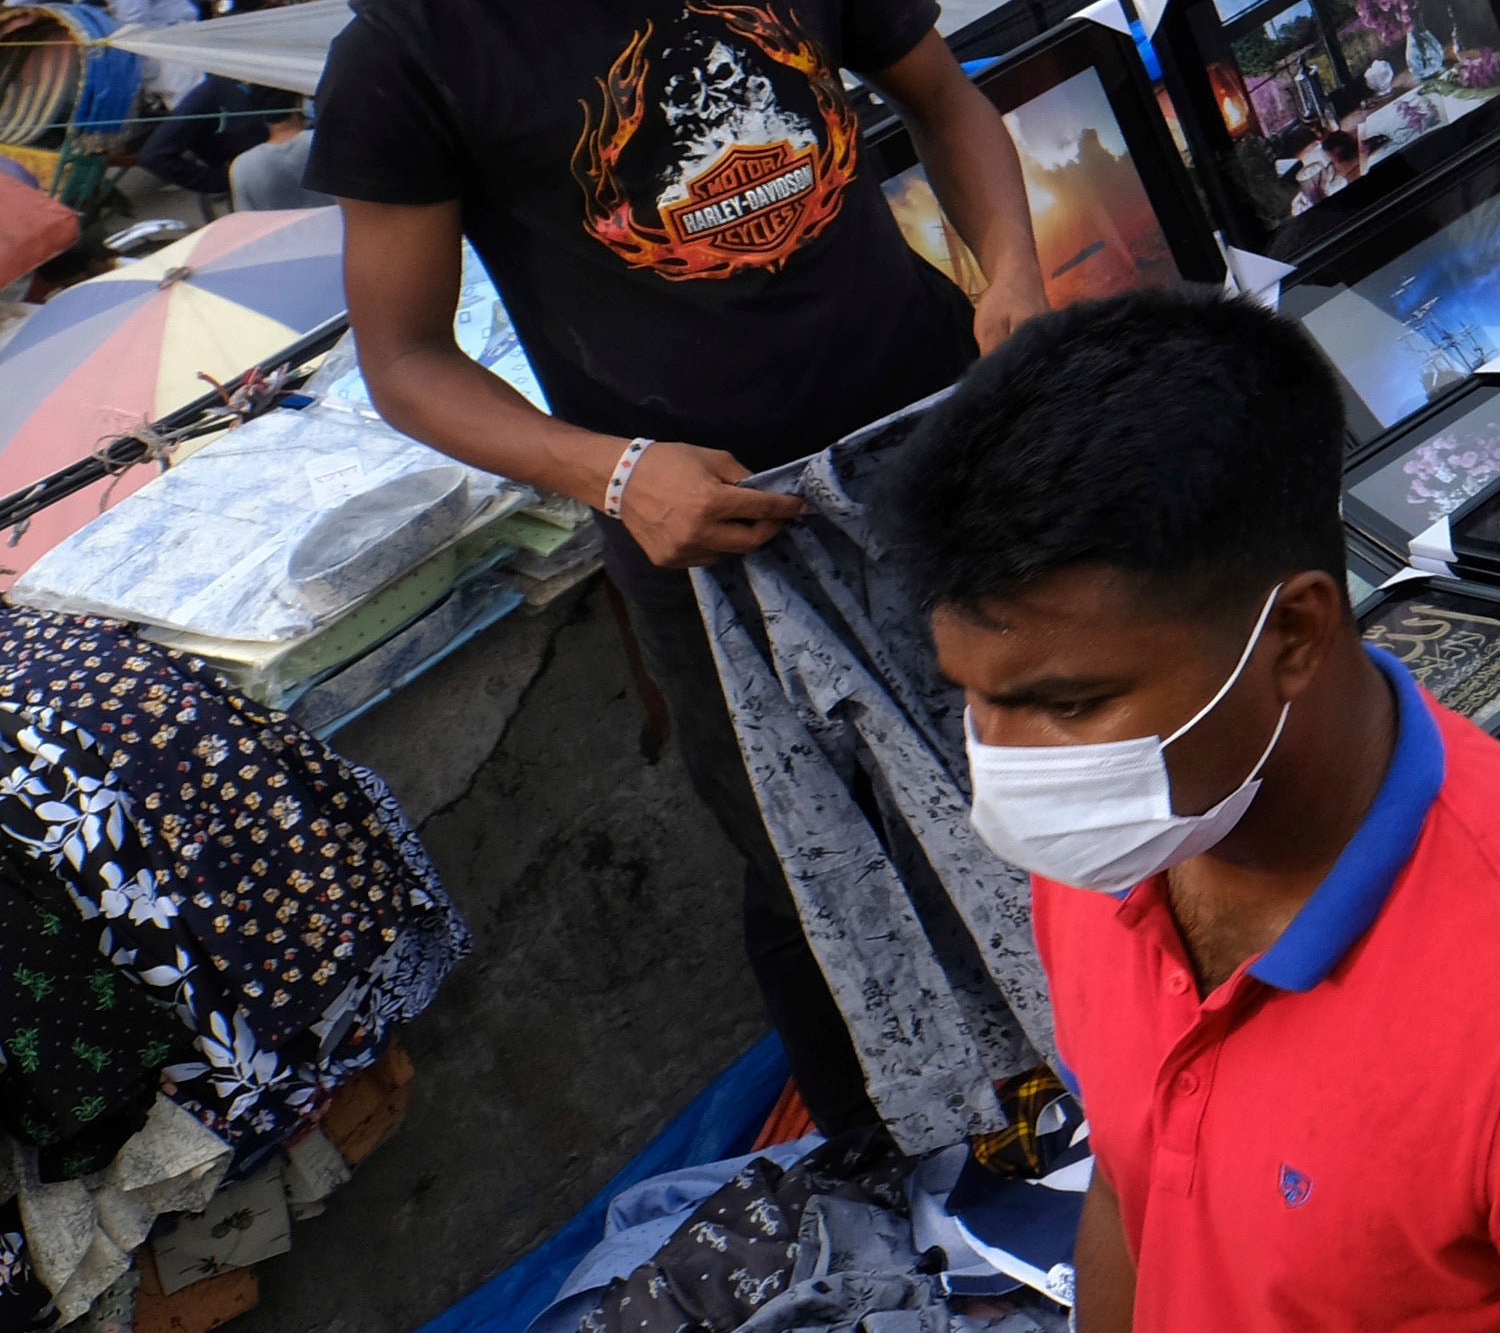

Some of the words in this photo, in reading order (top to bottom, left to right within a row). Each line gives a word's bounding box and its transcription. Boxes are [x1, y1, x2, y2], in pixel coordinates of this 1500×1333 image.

[704, 155, 778, 196] MOTOR
[683, 164, 814, 234] HARLEY-DAVIDSON
[722, 209, 796, 246] CYCLES
